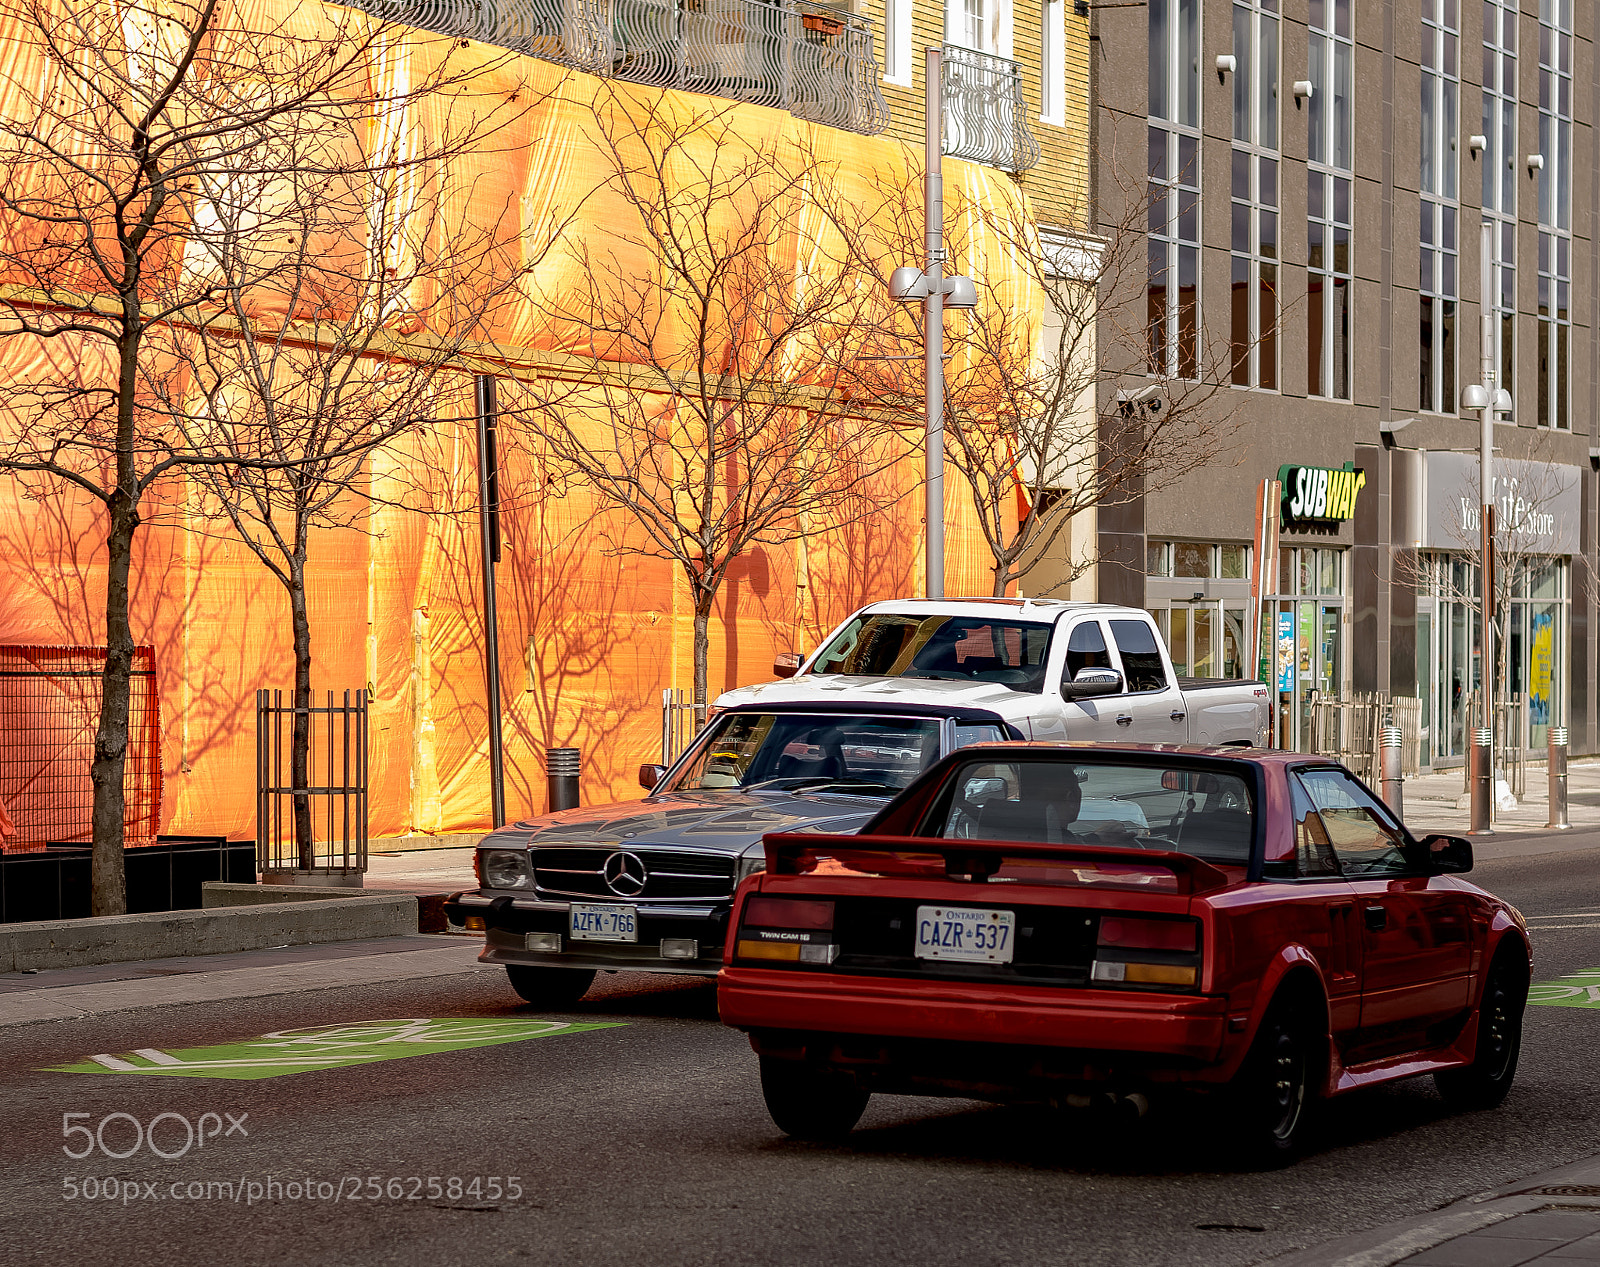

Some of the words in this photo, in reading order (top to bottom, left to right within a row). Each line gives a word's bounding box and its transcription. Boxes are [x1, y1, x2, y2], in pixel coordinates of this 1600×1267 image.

[1290, 467, 1366, 519] SUBWAY
[1461, 497, 1481, 532] You
[1527, 502, 1554, 536] Store
[573, 913, 603, 931] AZFK
[610, 914, 634, 932] 766
[946, 911, 985, 921] ONTARIO
[760, 931, 780, 939] TWIN
[920, 920, 962, 948] CAZR
[975, 924, 1009, 950] 537
